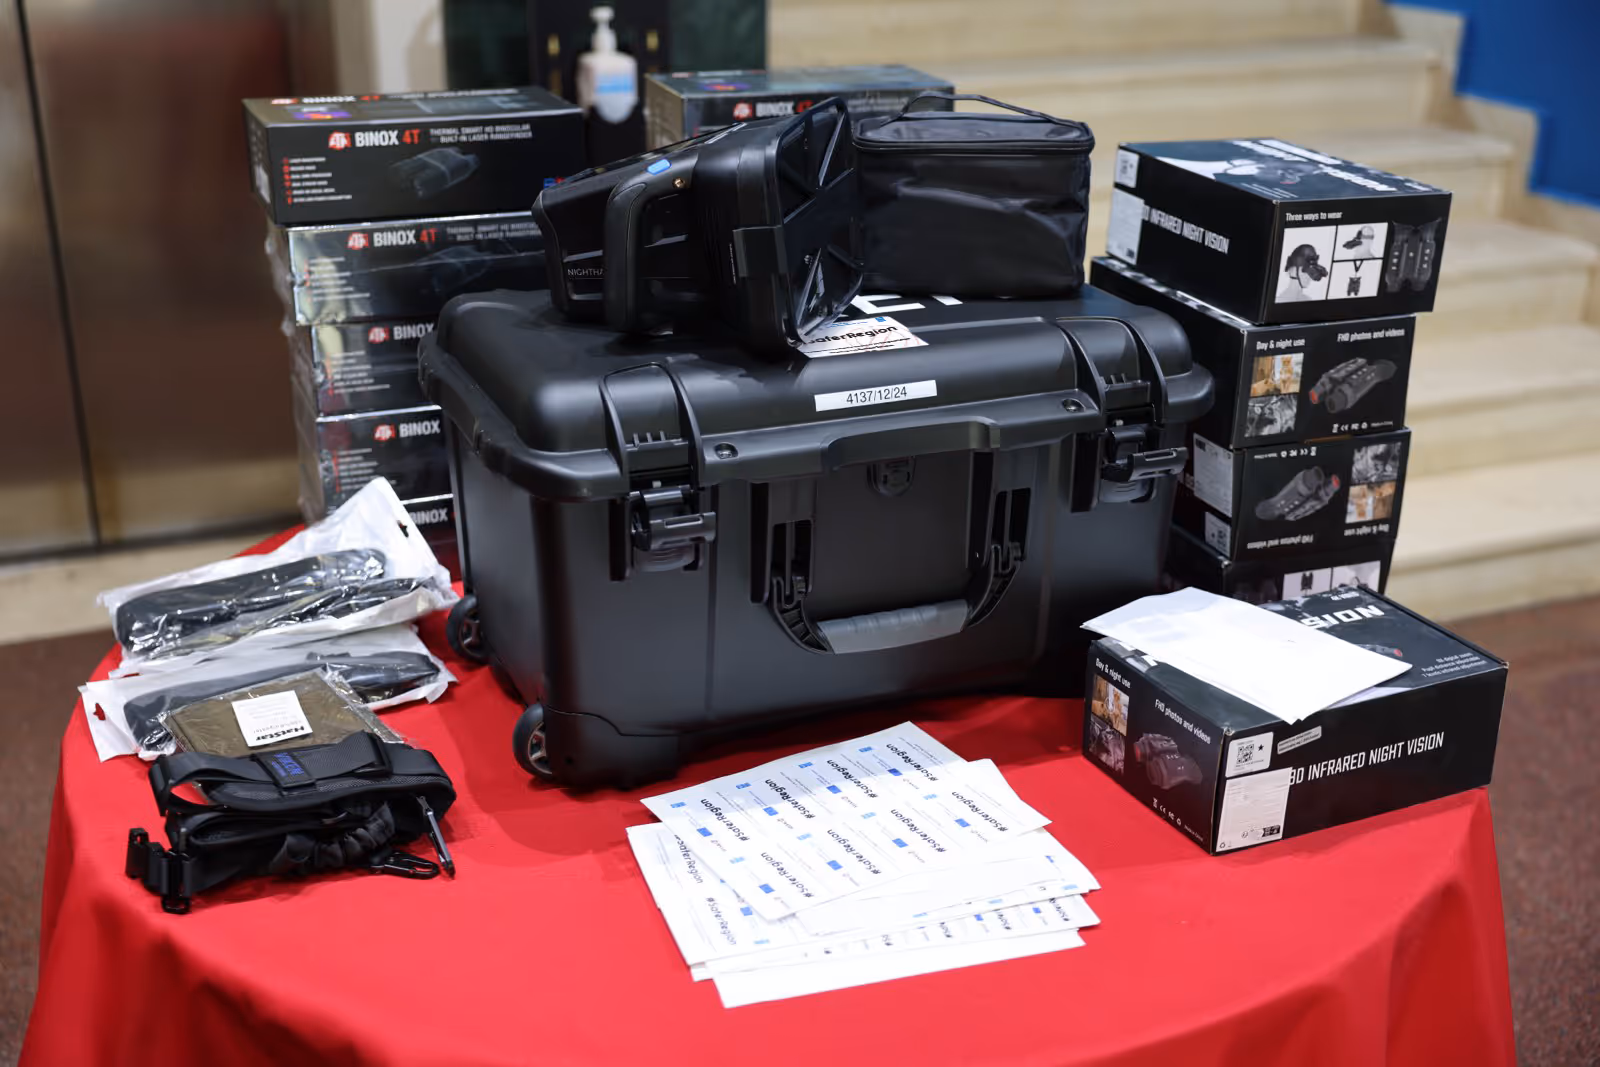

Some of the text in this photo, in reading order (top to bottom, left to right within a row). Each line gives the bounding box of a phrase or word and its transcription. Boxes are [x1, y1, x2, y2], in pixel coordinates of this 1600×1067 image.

[355, 130, 399, 147] BINOX
[402, 129, 420, 144] 4T
[1150, 208, 1182, 235] INFRARED
[1181, 221, 1204, 243] NIGHT
[1204, 230, 1230, 254] VISION
[1285, 211, 1343, 222] Three ways to wear
[373, 230, 416, 247] BINOX
[420, 228, 437, 242] 4T
[802, 326, 898, 345] aferRegion
[1256, 338, 1305, 351] Day & night use
[1337, 328, 1405, 342] FHD photos and videos
[846, 386, 908, 404] 4137/12/24
[399, 420, 440, 438] BINOX
[1095, 658, 1131, 688] Day & night use
[1154, 699, 1211, 744] FHD photos and videos
[886, 743, 938, 781] #SaferRegion
[1307, 752, 1366, 781] INFRARED
[1368, 742, 1405, 766] NIGHT
[1407, 731, 1445, 755] VISION
[826, 759, 878, 798] #SaferRegion
[765, 778, 815, 819] #SaferRegion
[951, 791, 1008, 832] #SaferRegion
[700, 798, 750, 841] #SaferRegion
[890, 808, 947, 852] #SaferRegion
[826, 828, 881, 874] #SaferRegion
[760, 851, 814, 898] #SaferRegion
